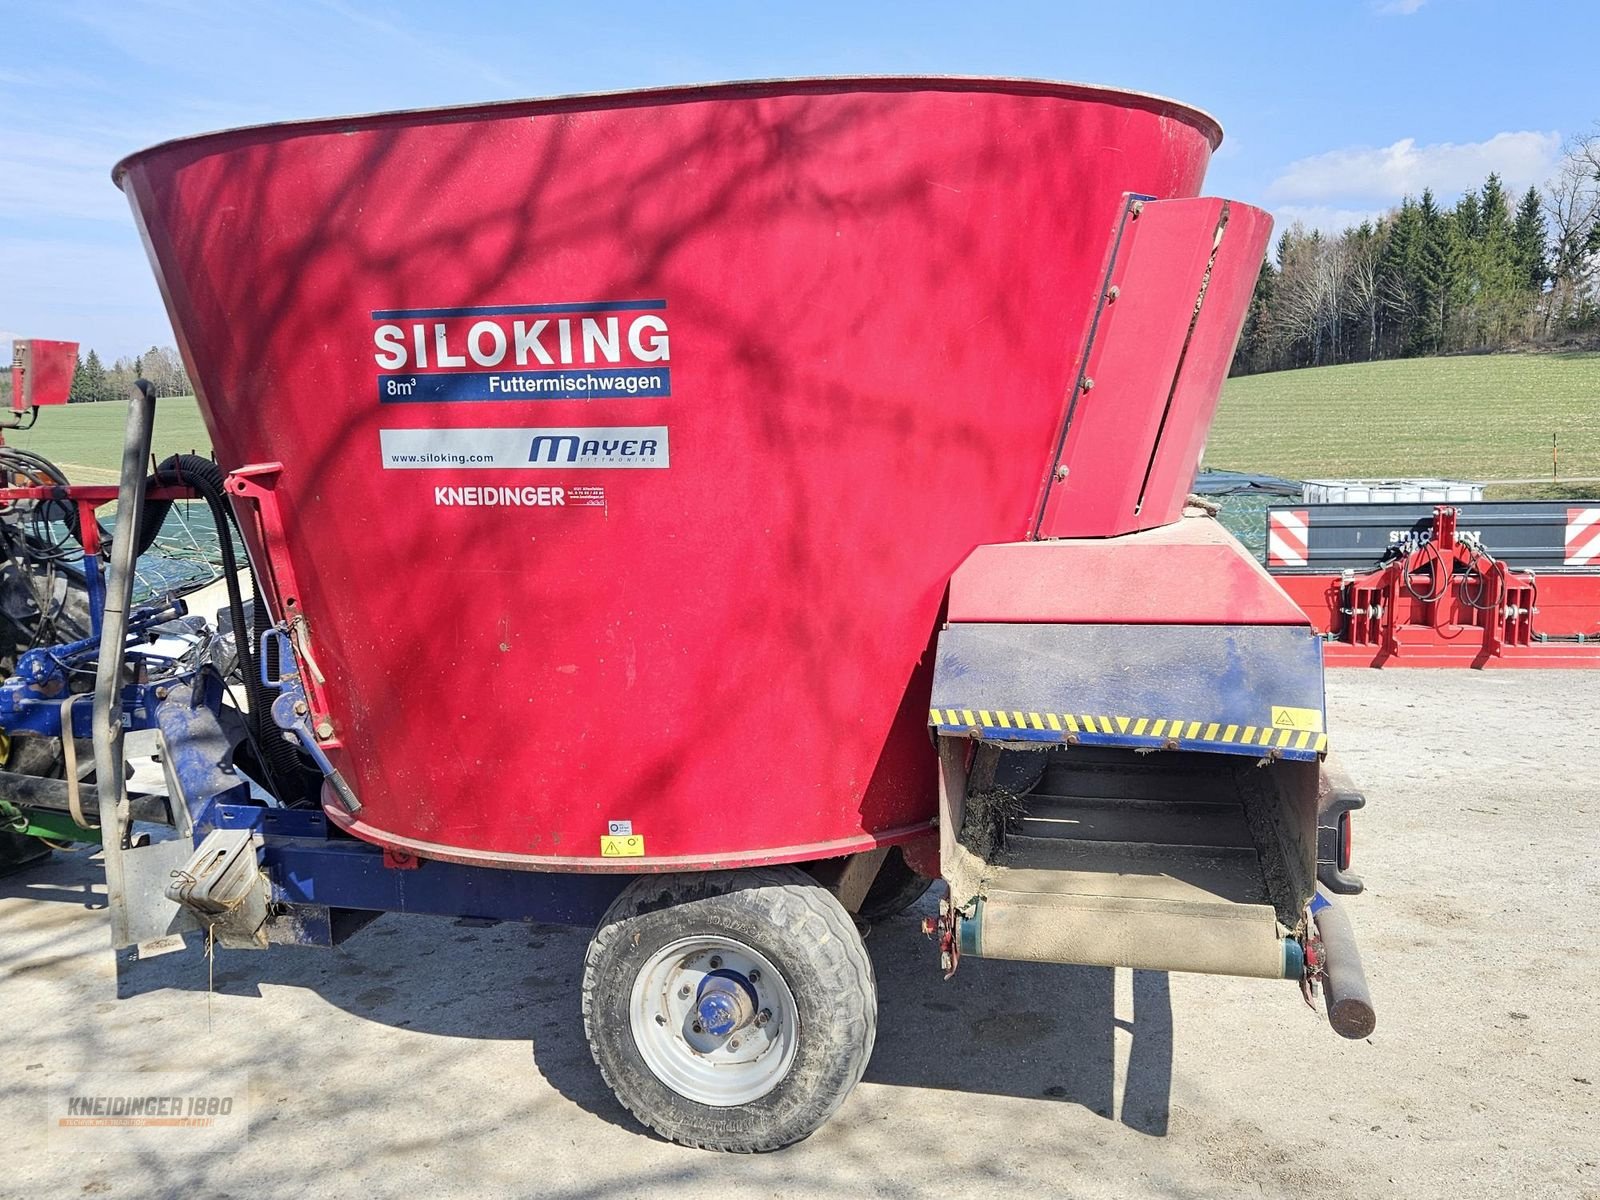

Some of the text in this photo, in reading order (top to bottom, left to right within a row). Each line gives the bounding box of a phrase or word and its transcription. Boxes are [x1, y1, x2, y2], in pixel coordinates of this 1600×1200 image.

[374, 315, 670, 370] SILOKING
[489, 375, 661, 395] Futtermischwagen
[391, 452, 494, 464] www.siloking.com
[528, 435, 657, 462] MAYER
[434, 486, 565, 506] KNEIDINGER
